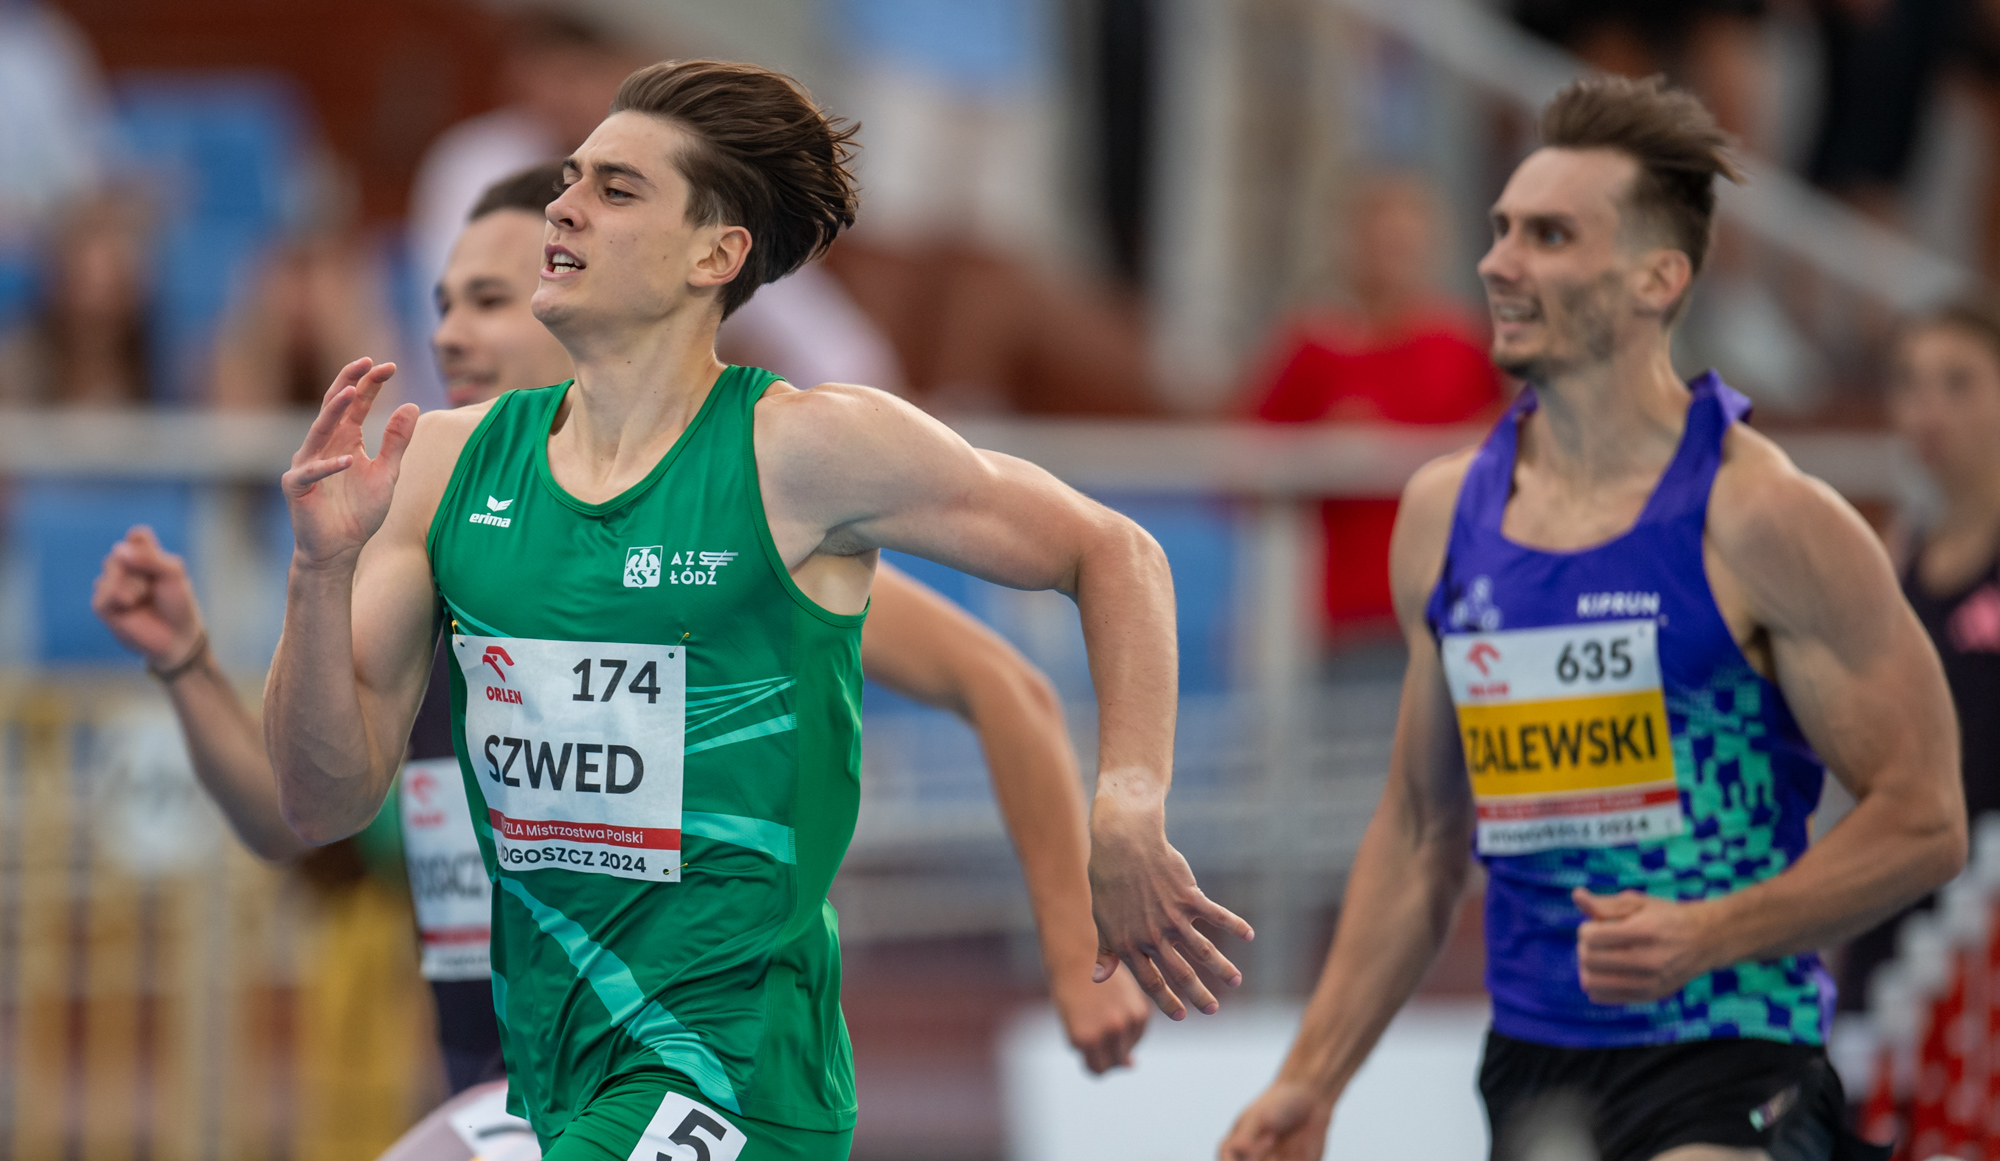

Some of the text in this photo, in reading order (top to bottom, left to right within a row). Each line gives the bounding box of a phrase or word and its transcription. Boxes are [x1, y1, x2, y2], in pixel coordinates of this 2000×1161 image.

[469, 512, 511, 528] erima
[1577, 592, 1660, 617] KIPRUN
[1556, 638, 1633, 683] 635
[486, 685, 523, 705] ORLEN
[572, 658, 661, 704] 174
[1468, 714, 1657, 774] ZALEWSKI
[484, 734, 644, 795] SZWED
[526, 824, 604, 840] Mistrzostwa
[606, 829, 643, 844] Polski
[500, 846, 647, 873] DGOSZCZ 2024
[656, 1108, 727, 1161] 5
